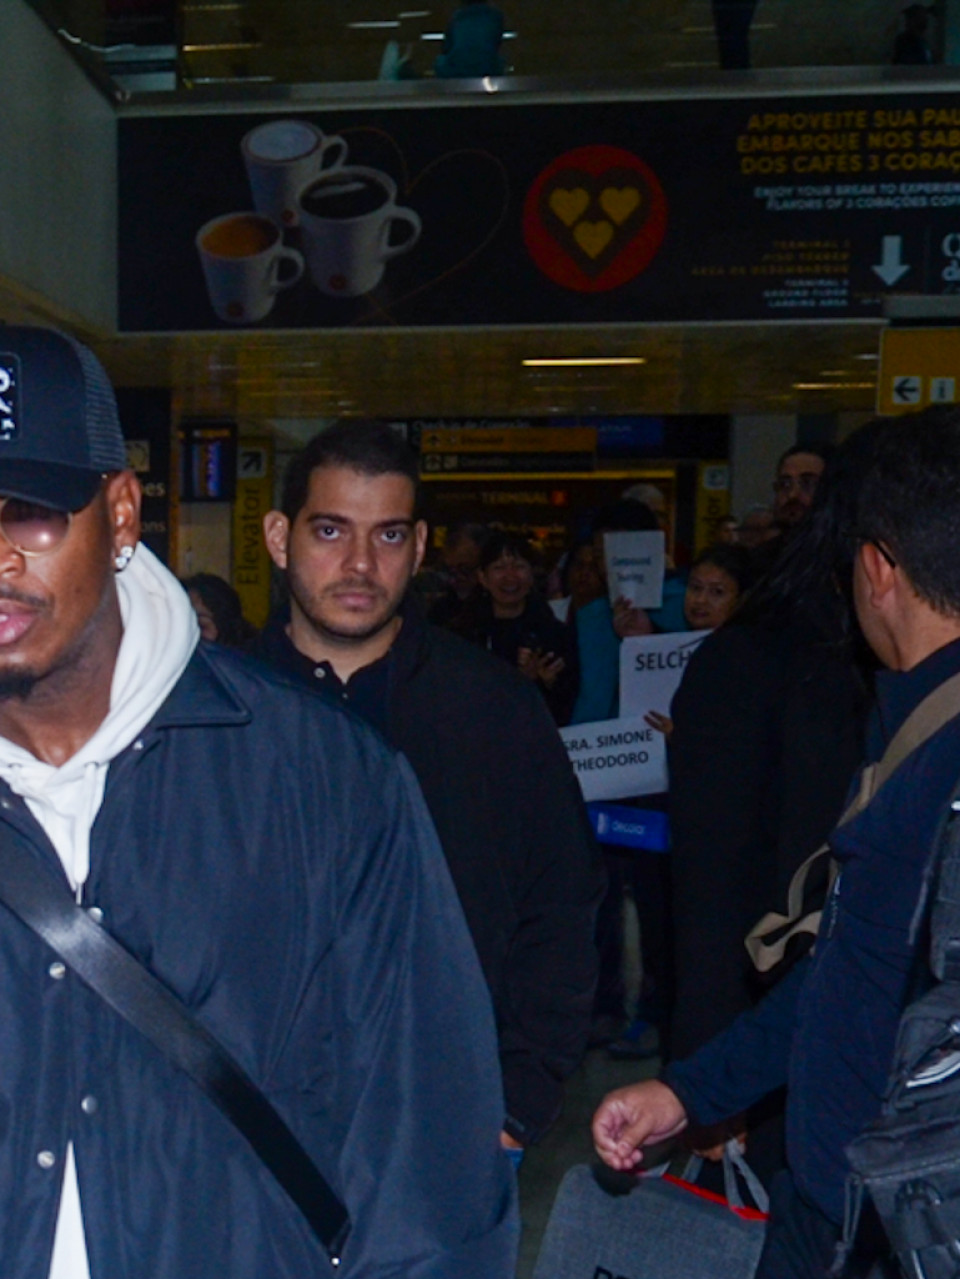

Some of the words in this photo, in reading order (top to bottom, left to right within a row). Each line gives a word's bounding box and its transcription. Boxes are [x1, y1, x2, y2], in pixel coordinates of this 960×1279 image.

[748, 110, 868, 131] APROVEITE
[874, 109, 918, 128] SUA
[738, 132, 860, 152] EMBARQUE
[868, 131, 913, 150] NOS
[741, 155, 788, 175] DOS
[869, 154, 880, 172] 3
[797, 185, 832, 197] YOUR
[880, 183, 897, 194] TO
[825, 198, 844, 210] OF
[237, 487, 260, 585] Elevator
[597, 729, 653, 749] SIMONE
